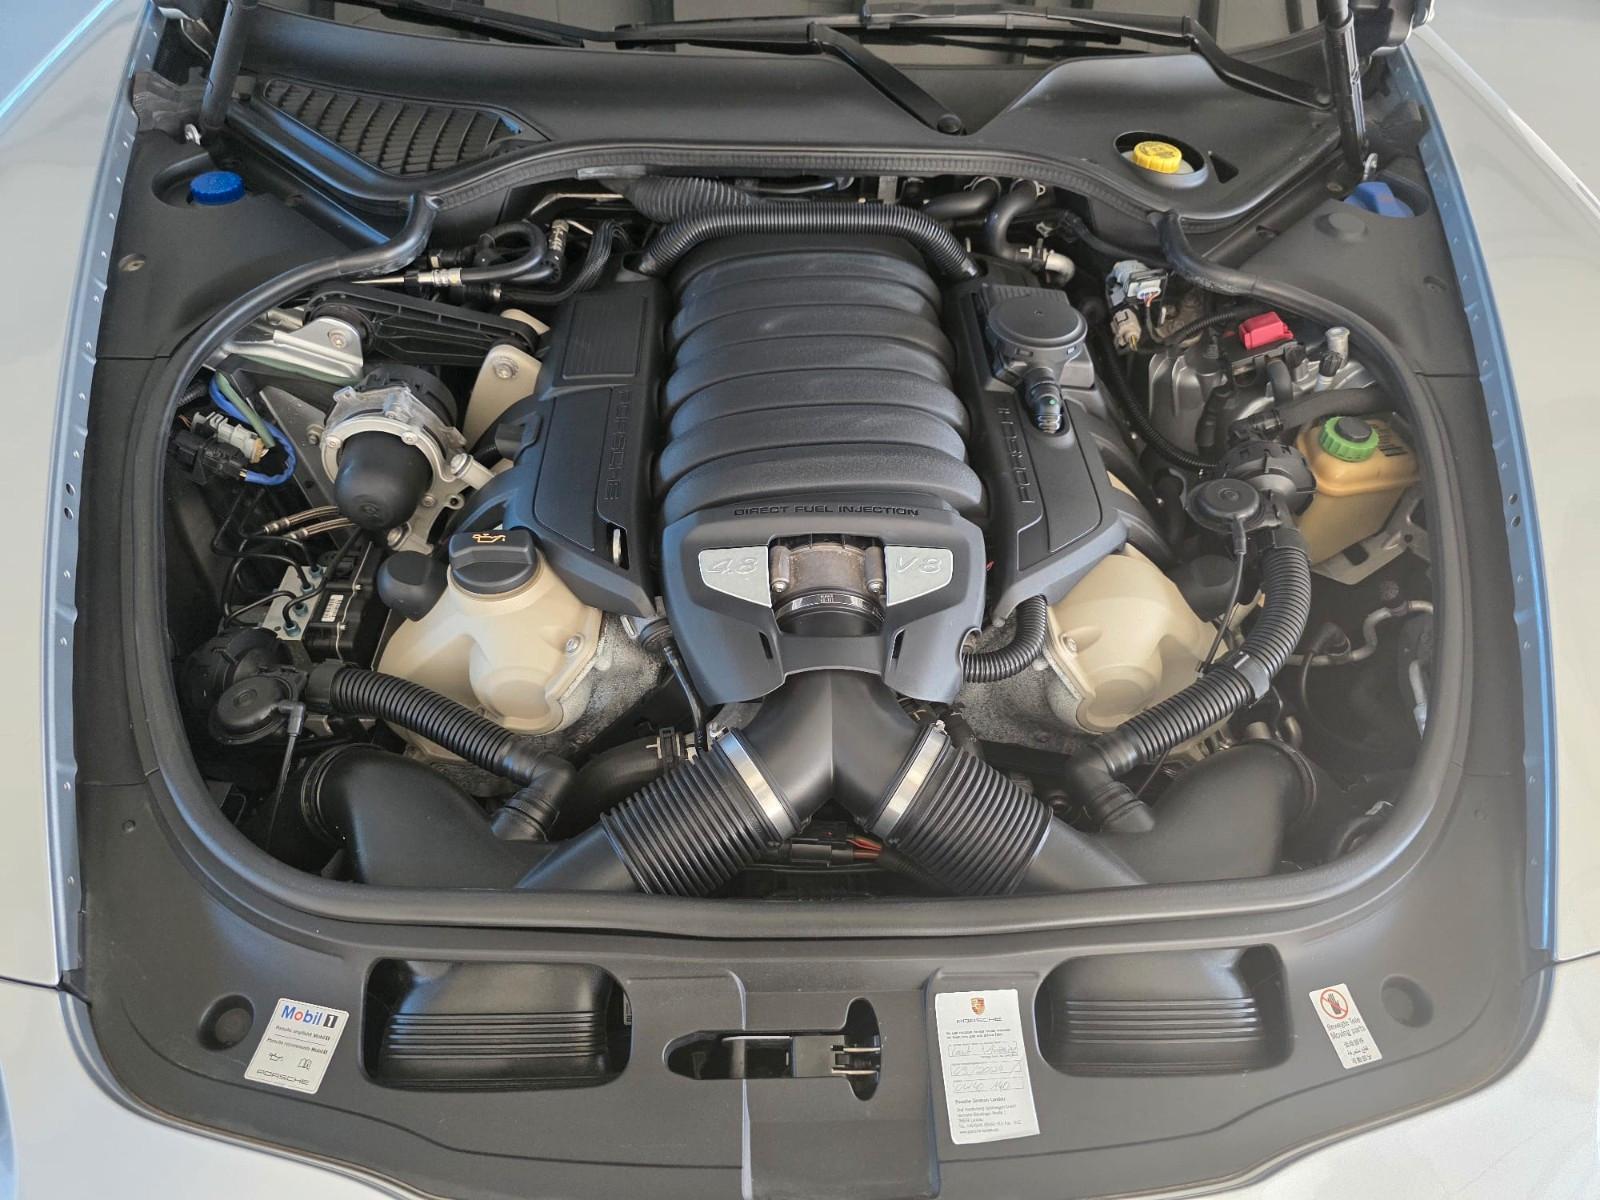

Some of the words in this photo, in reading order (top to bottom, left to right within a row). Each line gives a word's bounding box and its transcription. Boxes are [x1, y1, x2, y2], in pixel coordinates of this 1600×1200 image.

[604, 390, 632, 500] PORSCHE
[734, 506, 788, 516] DIRECT
[795, 505, 834, 513] FUEL
[838, 505, 919, 516] INJECTION
[896, 556, 942, 574] V8
[281, 1005, 324, 1026] Mobil
[257, 1069, 310, 1086] PORSCHE
